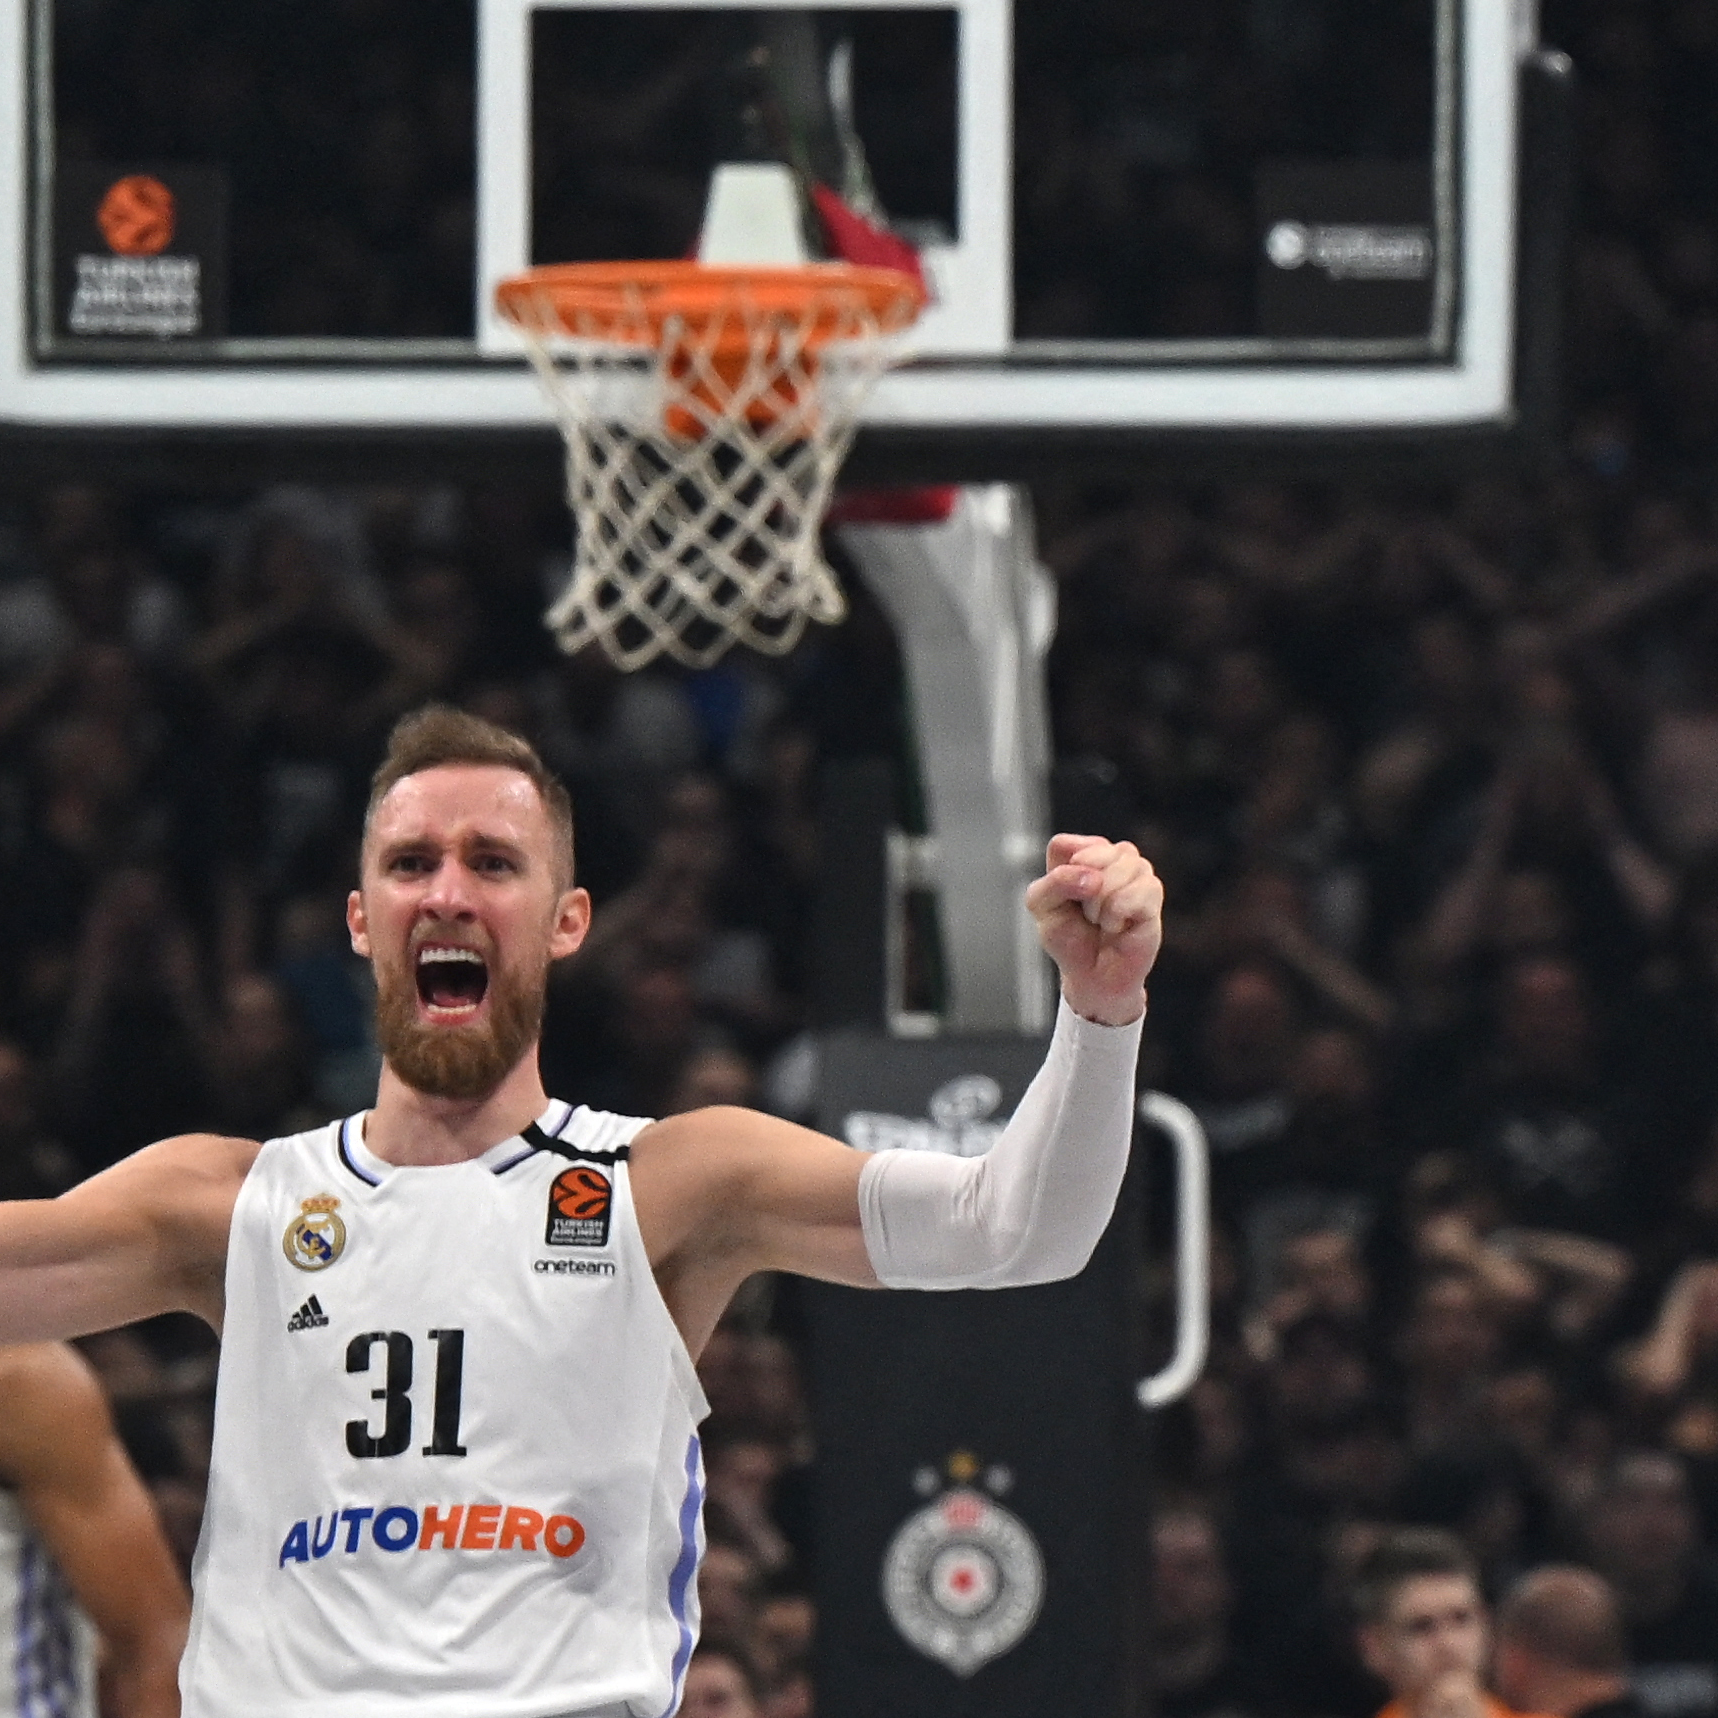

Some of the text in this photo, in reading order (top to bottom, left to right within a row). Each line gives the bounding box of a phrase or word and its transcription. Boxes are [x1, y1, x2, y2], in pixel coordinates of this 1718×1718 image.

[533, 1258, 616, 1277] oneteam
[287, 1314, 330, 1333] adidas
[345, 1328, 468, 1459] 31
[279, 1504, 586, 1569] AUTOHERO
